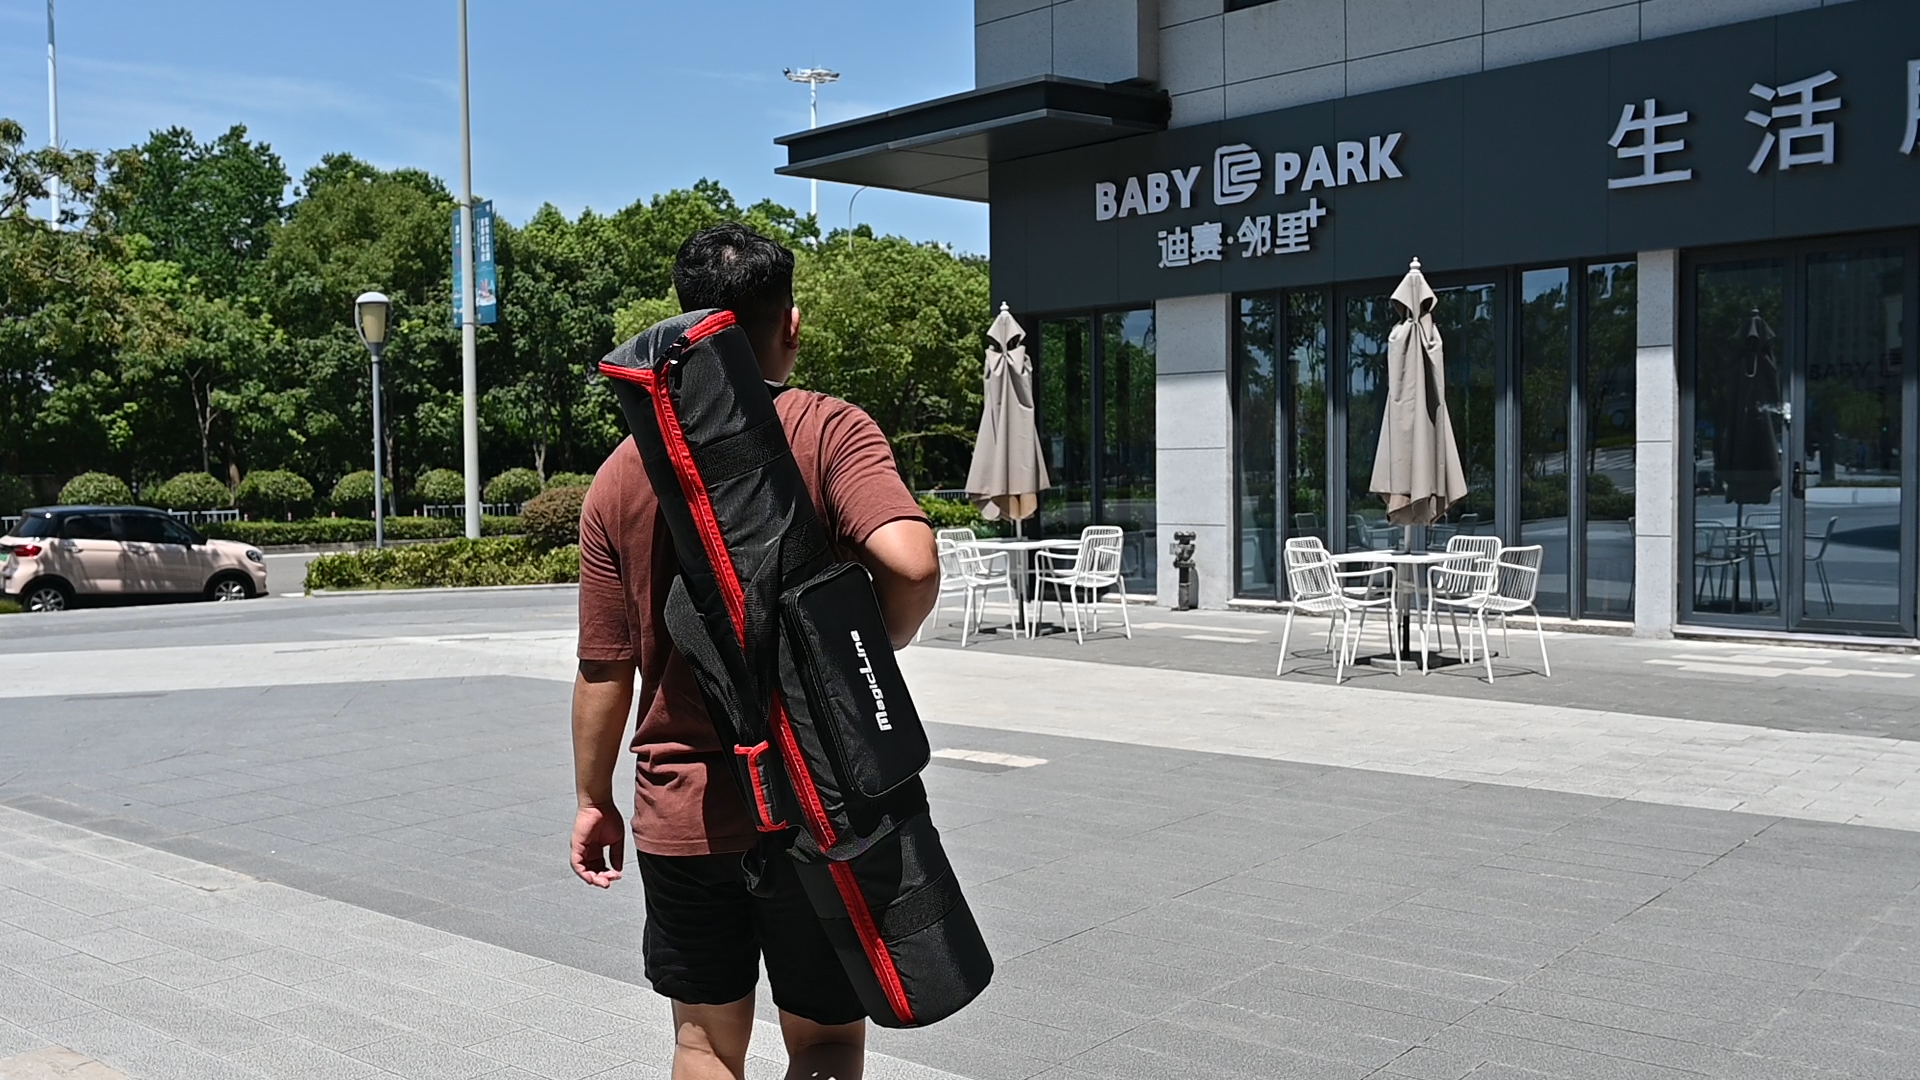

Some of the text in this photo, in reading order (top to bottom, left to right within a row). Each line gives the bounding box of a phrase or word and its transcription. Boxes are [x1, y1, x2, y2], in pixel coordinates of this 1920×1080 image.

[1607, 59, 1920, 190] 生活
[1095, 132, 1403, 221] BABY PARK
[850, 629, 893, 732] MagicLine
